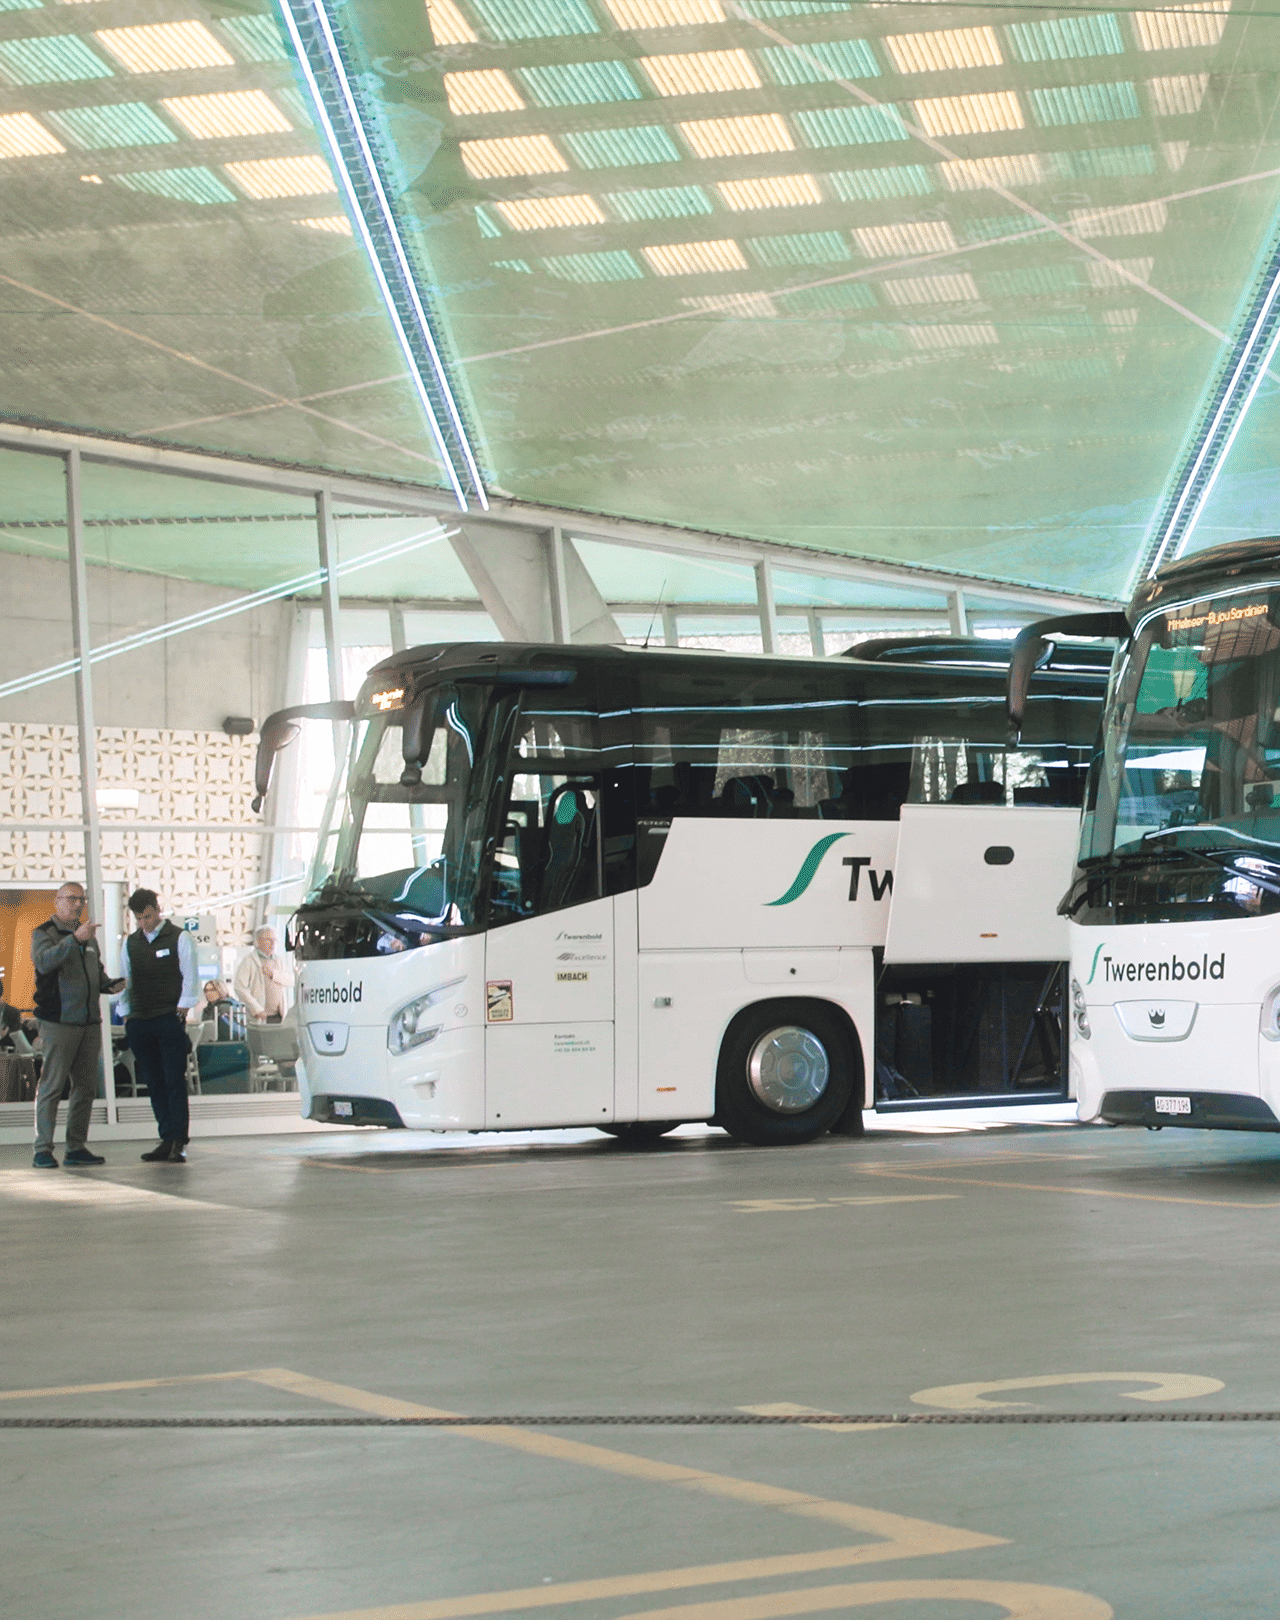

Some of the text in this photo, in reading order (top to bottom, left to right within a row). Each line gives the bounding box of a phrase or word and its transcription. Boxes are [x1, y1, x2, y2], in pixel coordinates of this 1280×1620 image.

[563, 933, 603, 941] Twerenbold
[1104, 952, 1226, 983] Twerenbold
[557, 972, 588, 981] IMBACH
[301, 981, 363, 1004] Twerenbold
